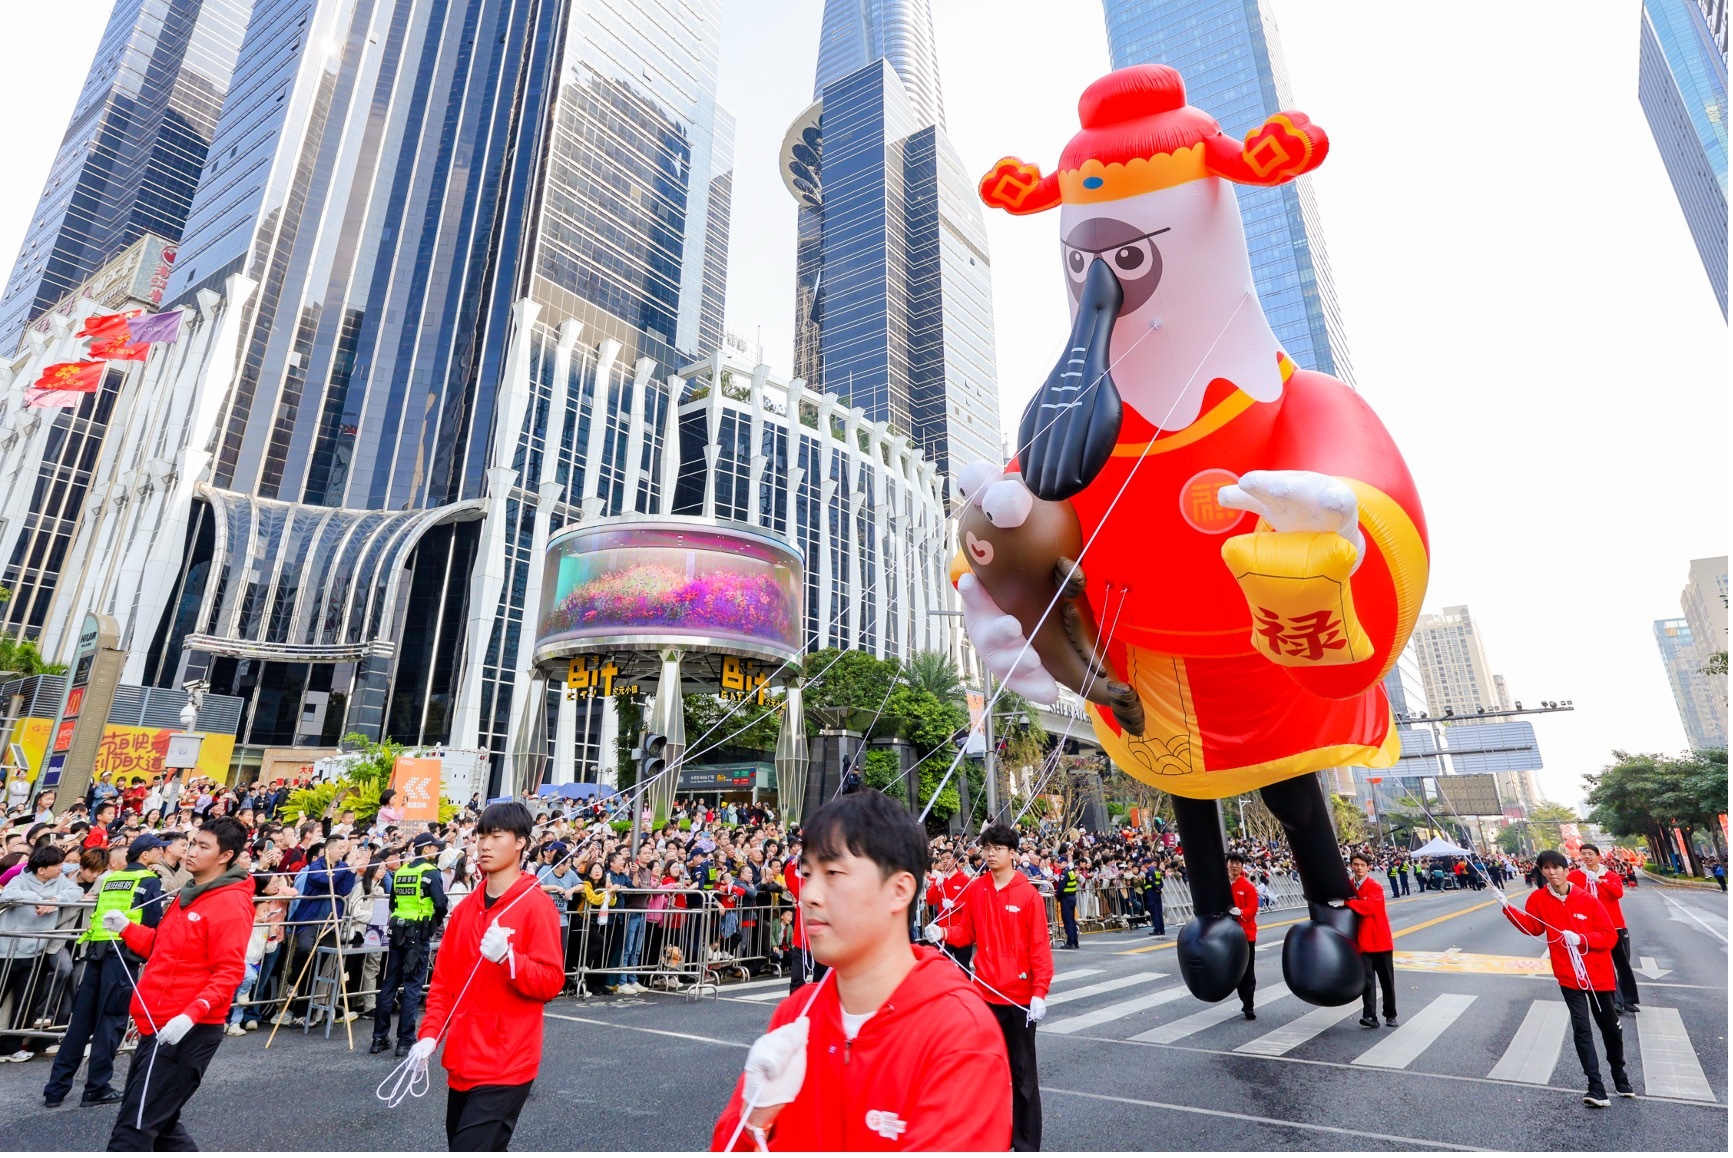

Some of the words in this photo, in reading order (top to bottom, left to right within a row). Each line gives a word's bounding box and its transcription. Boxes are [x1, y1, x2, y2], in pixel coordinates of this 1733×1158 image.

[1254, 606, 1347, 660] 禄
[568, 656, 618, 697] Bit
[722, 656, 770, 706] Bit
